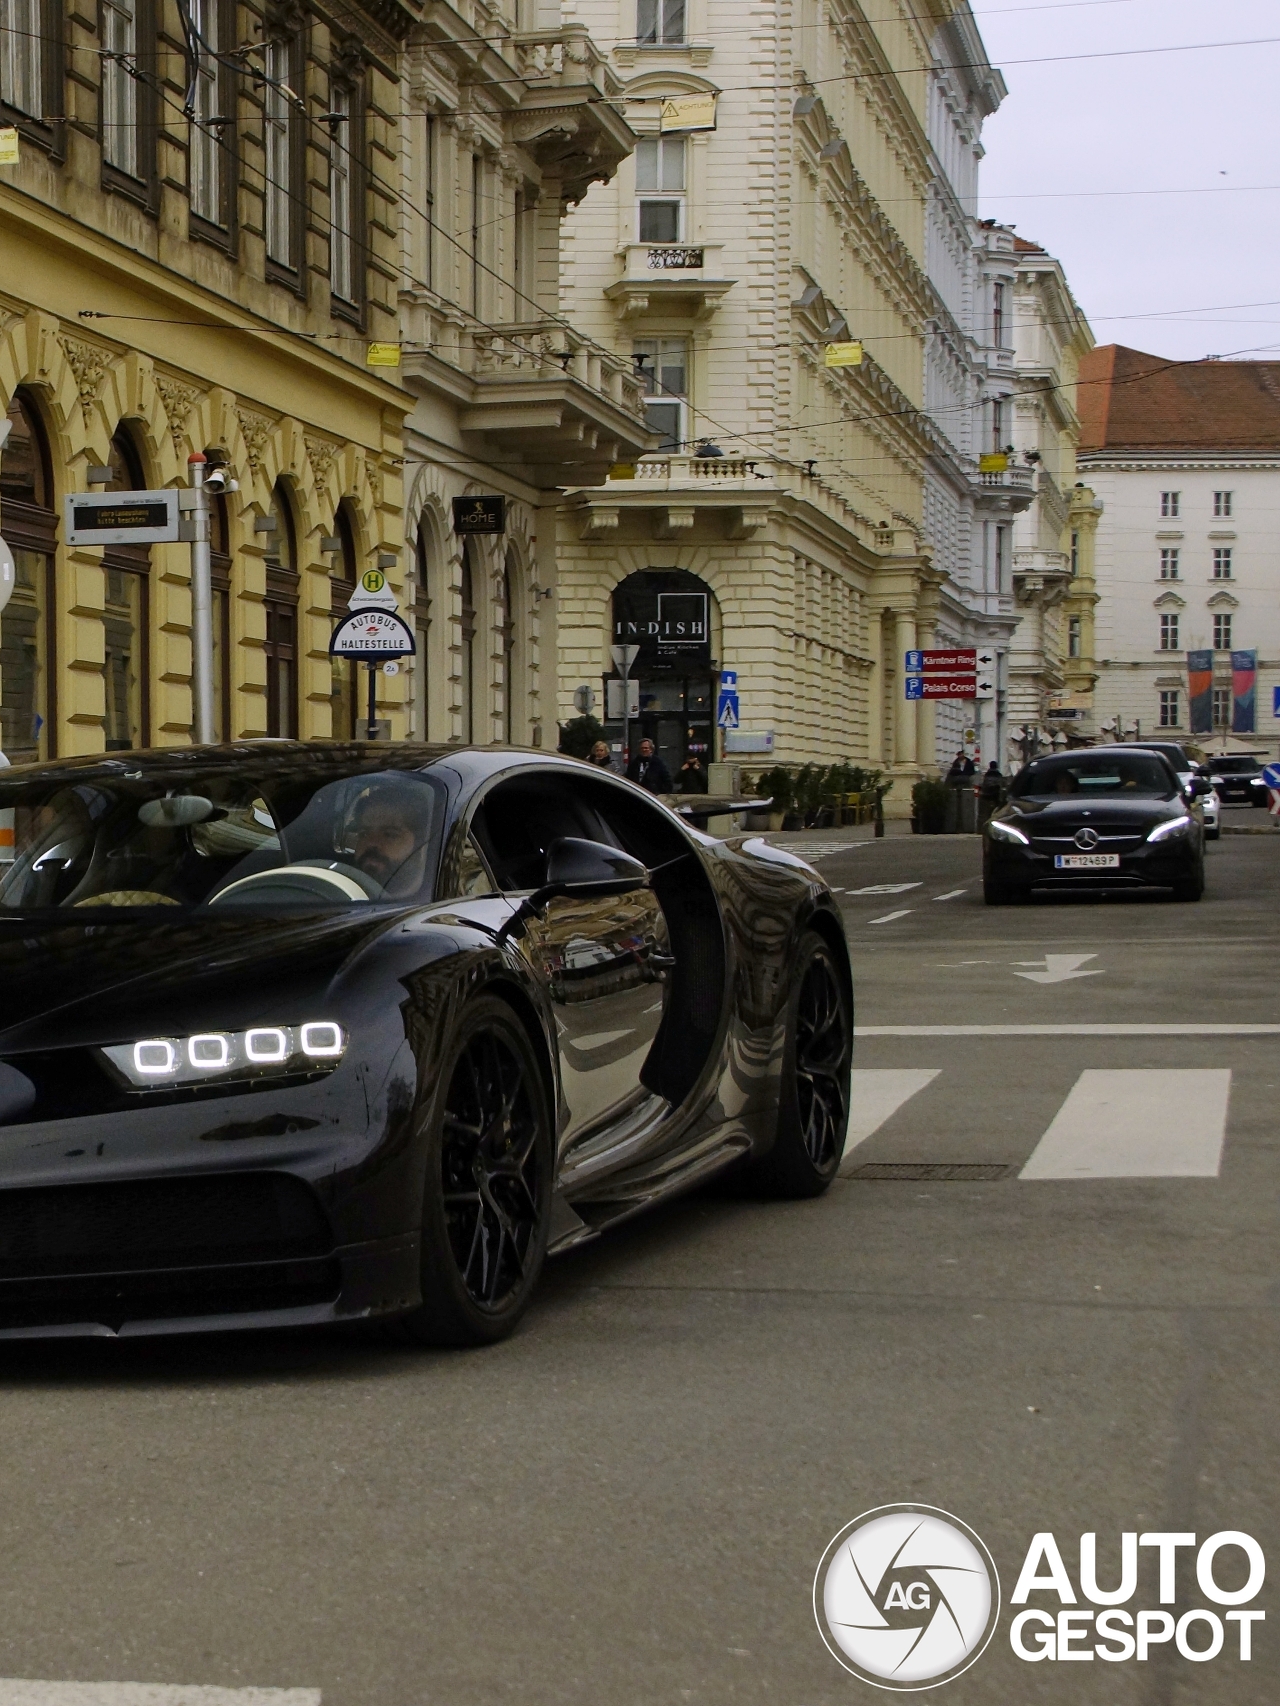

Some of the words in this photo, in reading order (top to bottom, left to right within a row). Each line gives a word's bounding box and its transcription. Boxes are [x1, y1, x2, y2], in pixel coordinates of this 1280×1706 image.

[460, 513, 496, 523] HOME
[367, 574, 379, 589] H
[350, 614, 397, 631] AUTOBUS
[341, 639, 405, 649] HALTESTELLE
[923, 656, 956, 665] Kärntner
[957, 655, 975, 666] Ring
[923, 683, 948, 692] Palais
[949, 682, 975, 692] Corso
